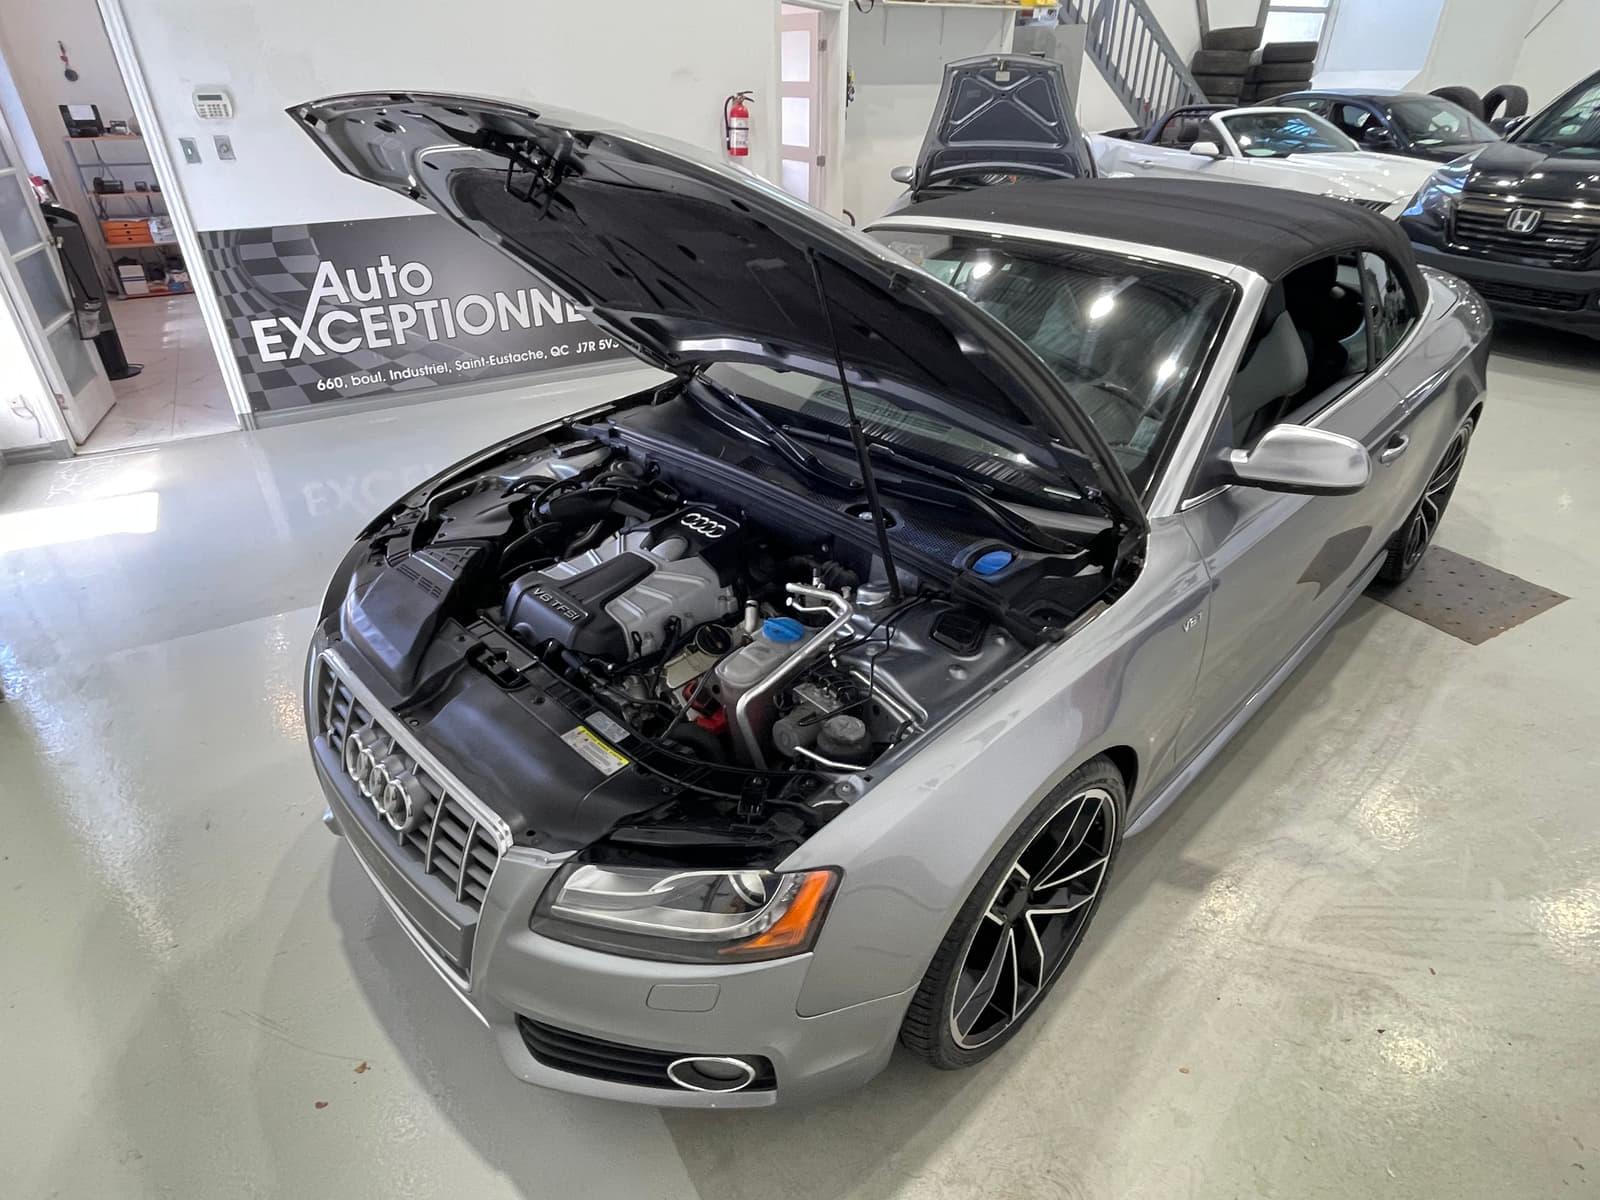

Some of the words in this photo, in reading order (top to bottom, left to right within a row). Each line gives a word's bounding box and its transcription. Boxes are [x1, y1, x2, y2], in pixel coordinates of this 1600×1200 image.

[311, 255, 433, 304] Auto
[316, 378, 348, 391] 660,
[352, 372, 387, 387] boul.
[389, 362, 452, 380] Industriel,
[455, 349, 548, 371] Saint-Eustache,
[550, 344, 569, 357] QC
[576, 340, 596, 354] J7R
[533, 588, 553, 602] V6
[551, 600, 580, 620] TFSI
